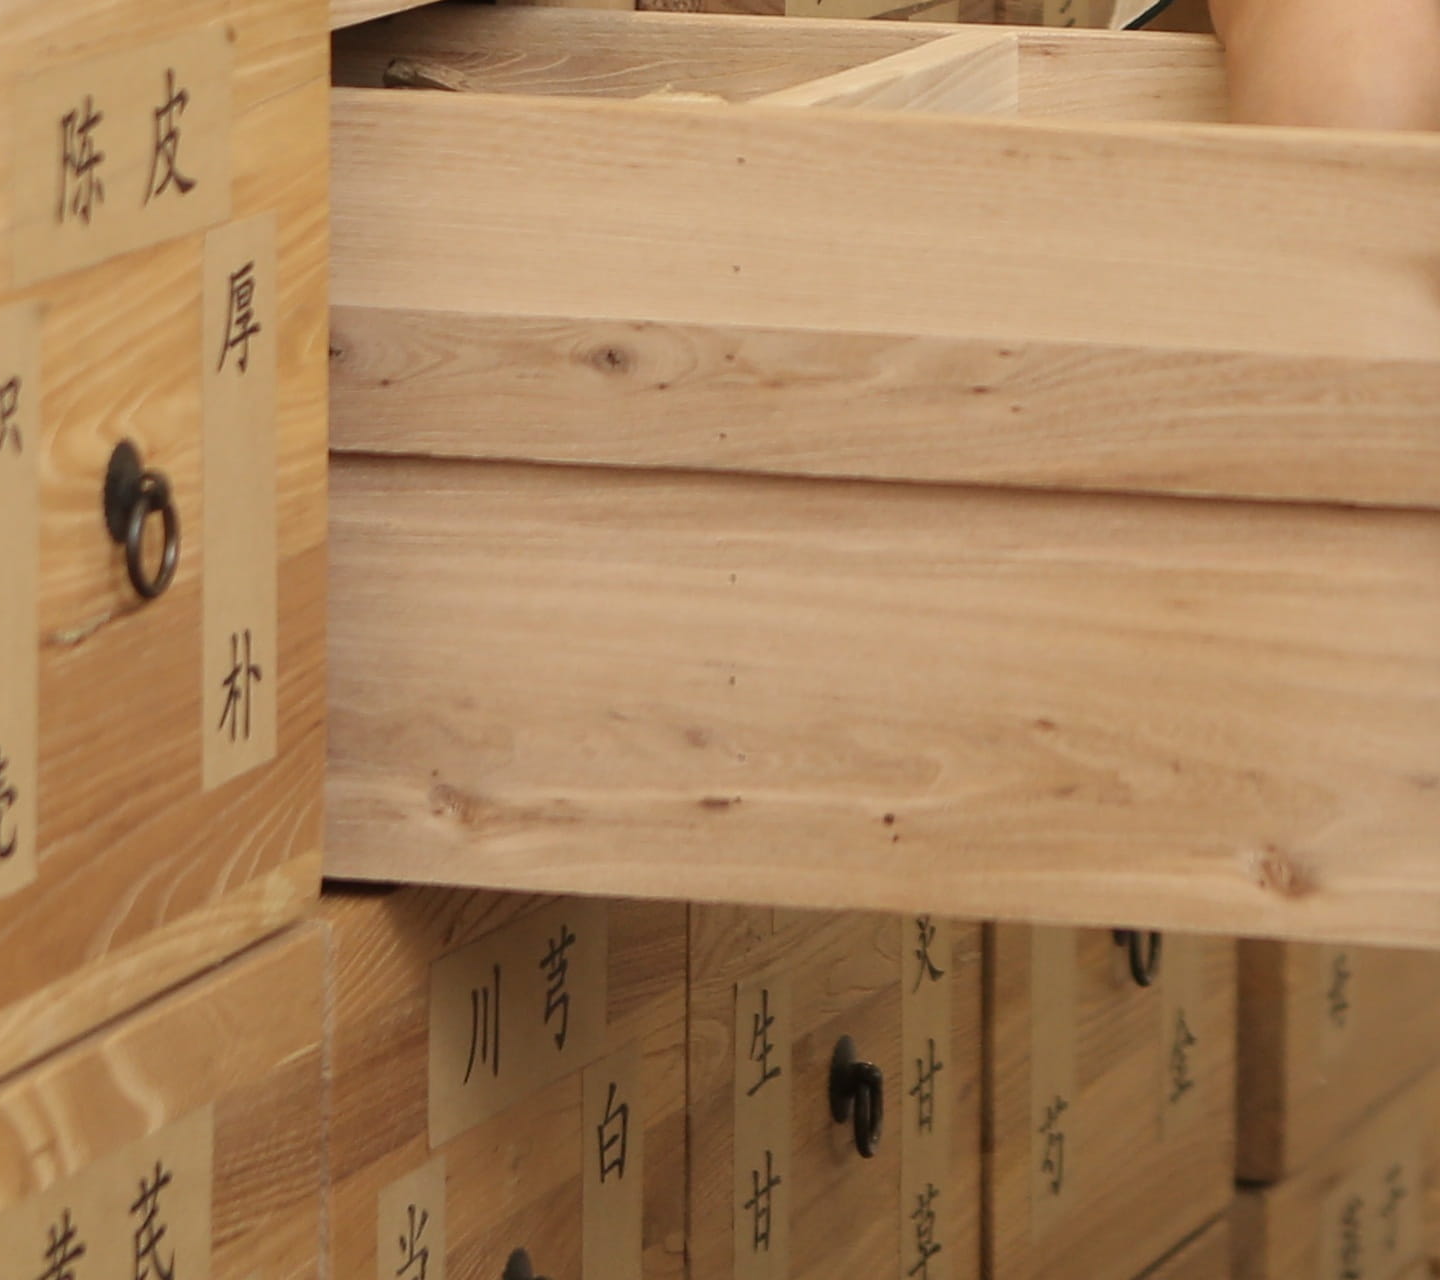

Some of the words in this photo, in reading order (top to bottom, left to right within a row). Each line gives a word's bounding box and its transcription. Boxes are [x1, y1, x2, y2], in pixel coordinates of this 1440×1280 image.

[56, 69, 196, 223] 陈皮
[217, 261, 262, 741] 厚朴
[463, 924, 579, 1087] 川芎
